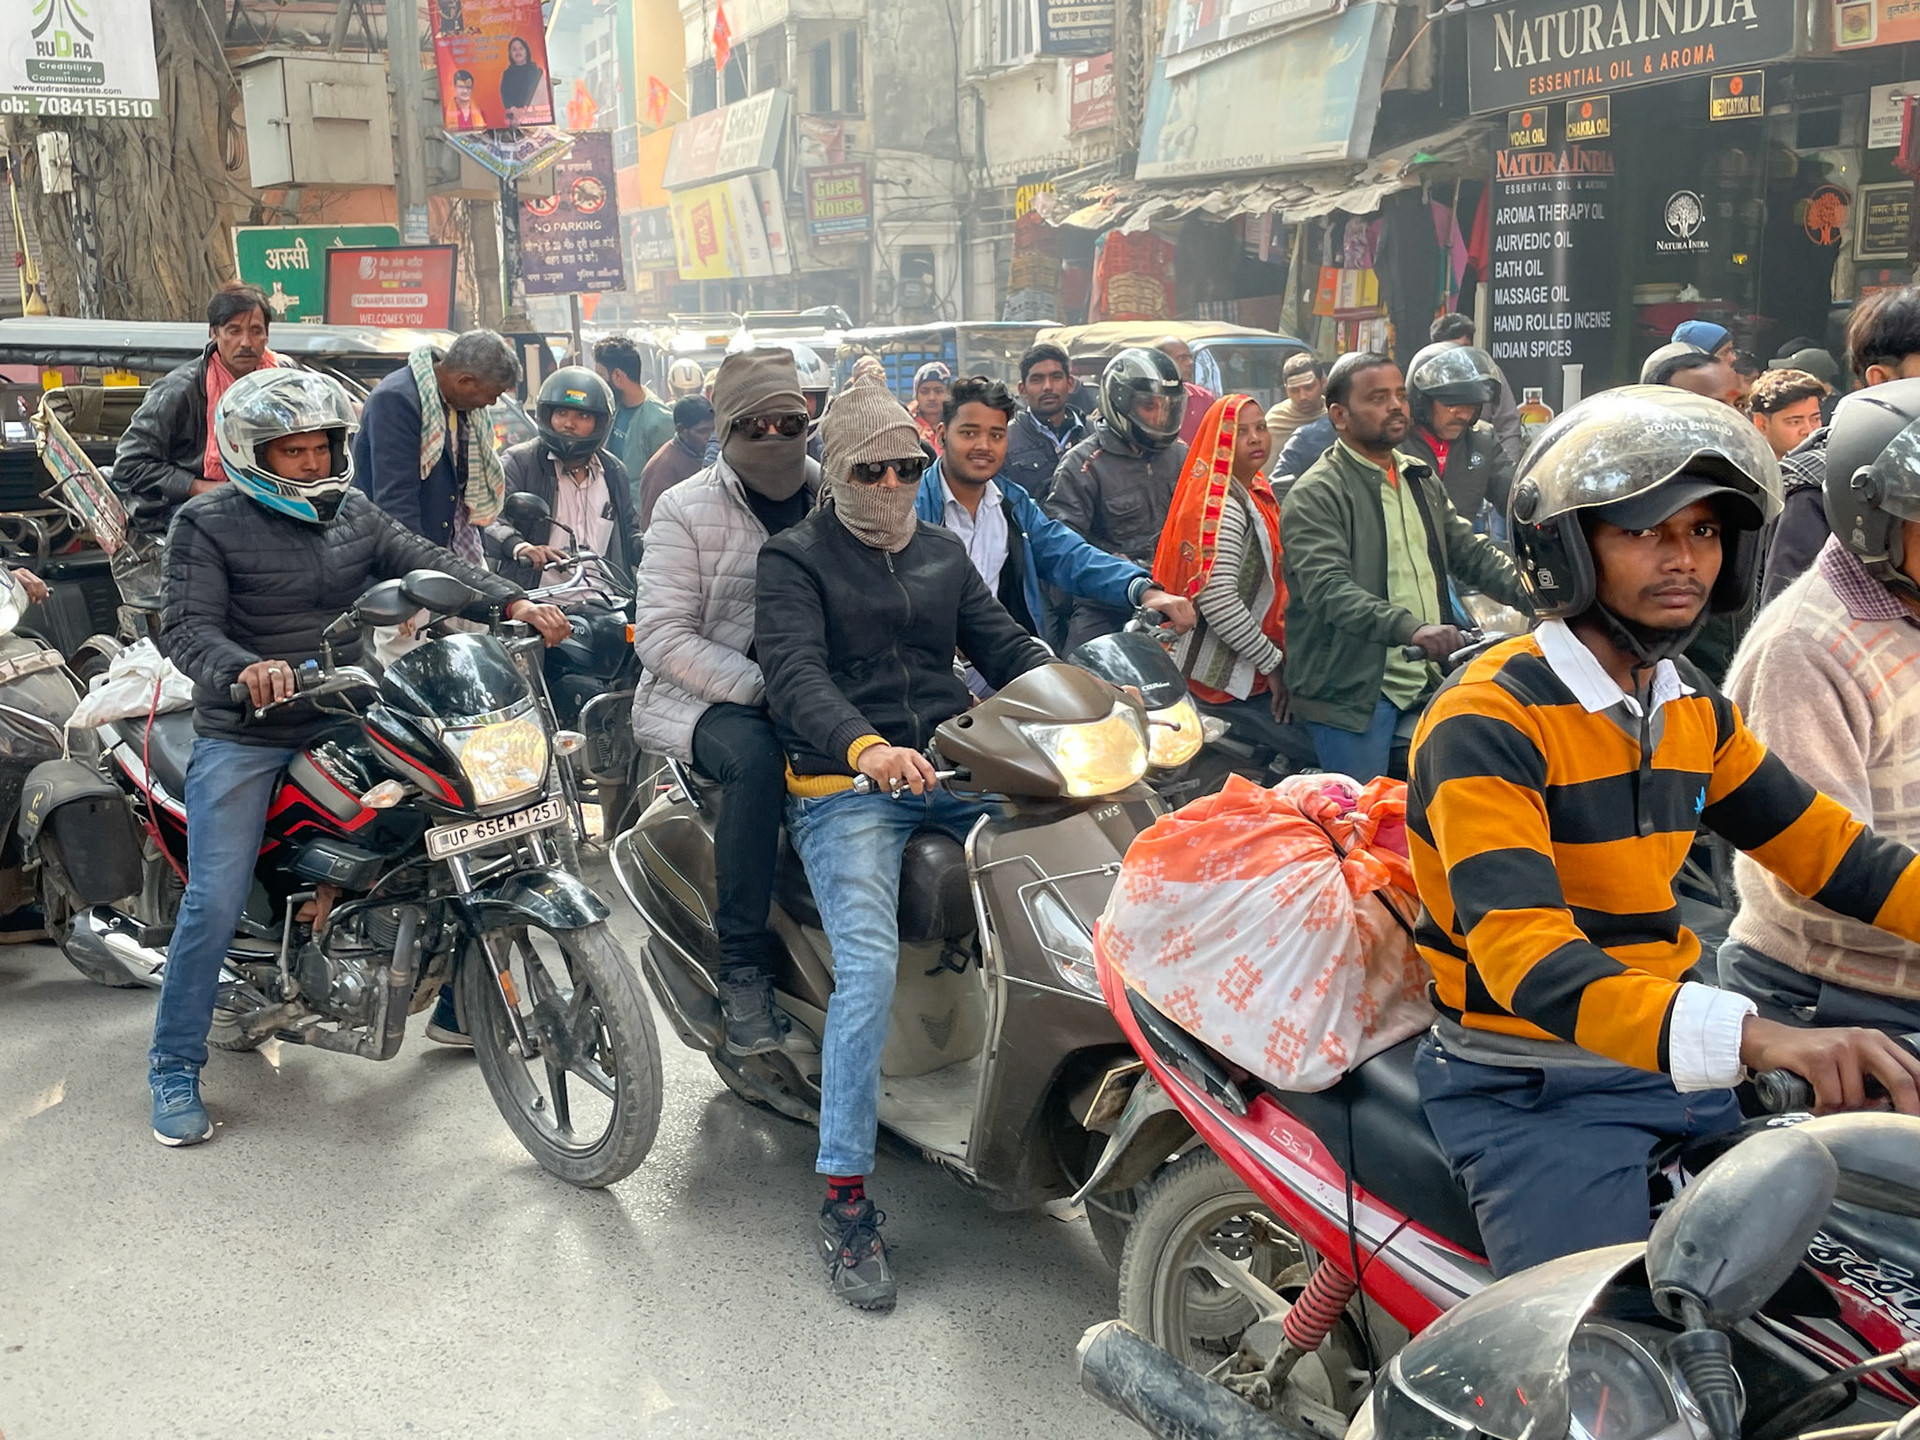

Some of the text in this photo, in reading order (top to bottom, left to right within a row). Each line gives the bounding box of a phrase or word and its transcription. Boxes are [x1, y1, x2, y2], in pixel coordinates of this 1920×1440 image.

[35, 30, 93, 59] RUDRA
[39, 62, 92, 73] Credibility
[1529, 43, 1715, 95] ESSENTIAL OIL & AROMA
[32, 74, 102, 84] Commitments
[13, 84, 122, 95] www.rudrarealestate.com
[0, 96, 153, 117] ob: 7084151510
[1712, 95, 1761, 117] MEDITATION OIL
[1510, 128, 1545, 146] YOGA OIL
[1568, 118, 1609, 138] CHAKRA OIL
[1505, 182, 1552, 195] ESSENTIAL
[1556, 181, 1571, 191] OIL
[1496, 202, 1605, 225] AROMA THERAPY OIL
[535, 220, 602, 233] NO PARKING
[1495, 231, 1573, 252] AURVEDIC OIL
[1656, 239, 1710, 251] NATURA INDIA
[265, 238, 311, 270] अस्सी
[1495, 259, 1544, 278] BATH OIL
[395, 295, 424, 305] BRANCH
[1494, 285, 1571, 305] MASSAGE OIL
[359, 313, 424, 325] WELCOMES YOU
[1493, 311, 1612, 332] HAND ROLLED INCENSE
[1492, 340, 1572, 359] INDIAN SPICES
[1643, 421, 1687, 434] ROYAL
[1094, 804, 1121, 821] TVS
[448, 828, 469, 846] UP
[525, 801, 559, 825] 1251
